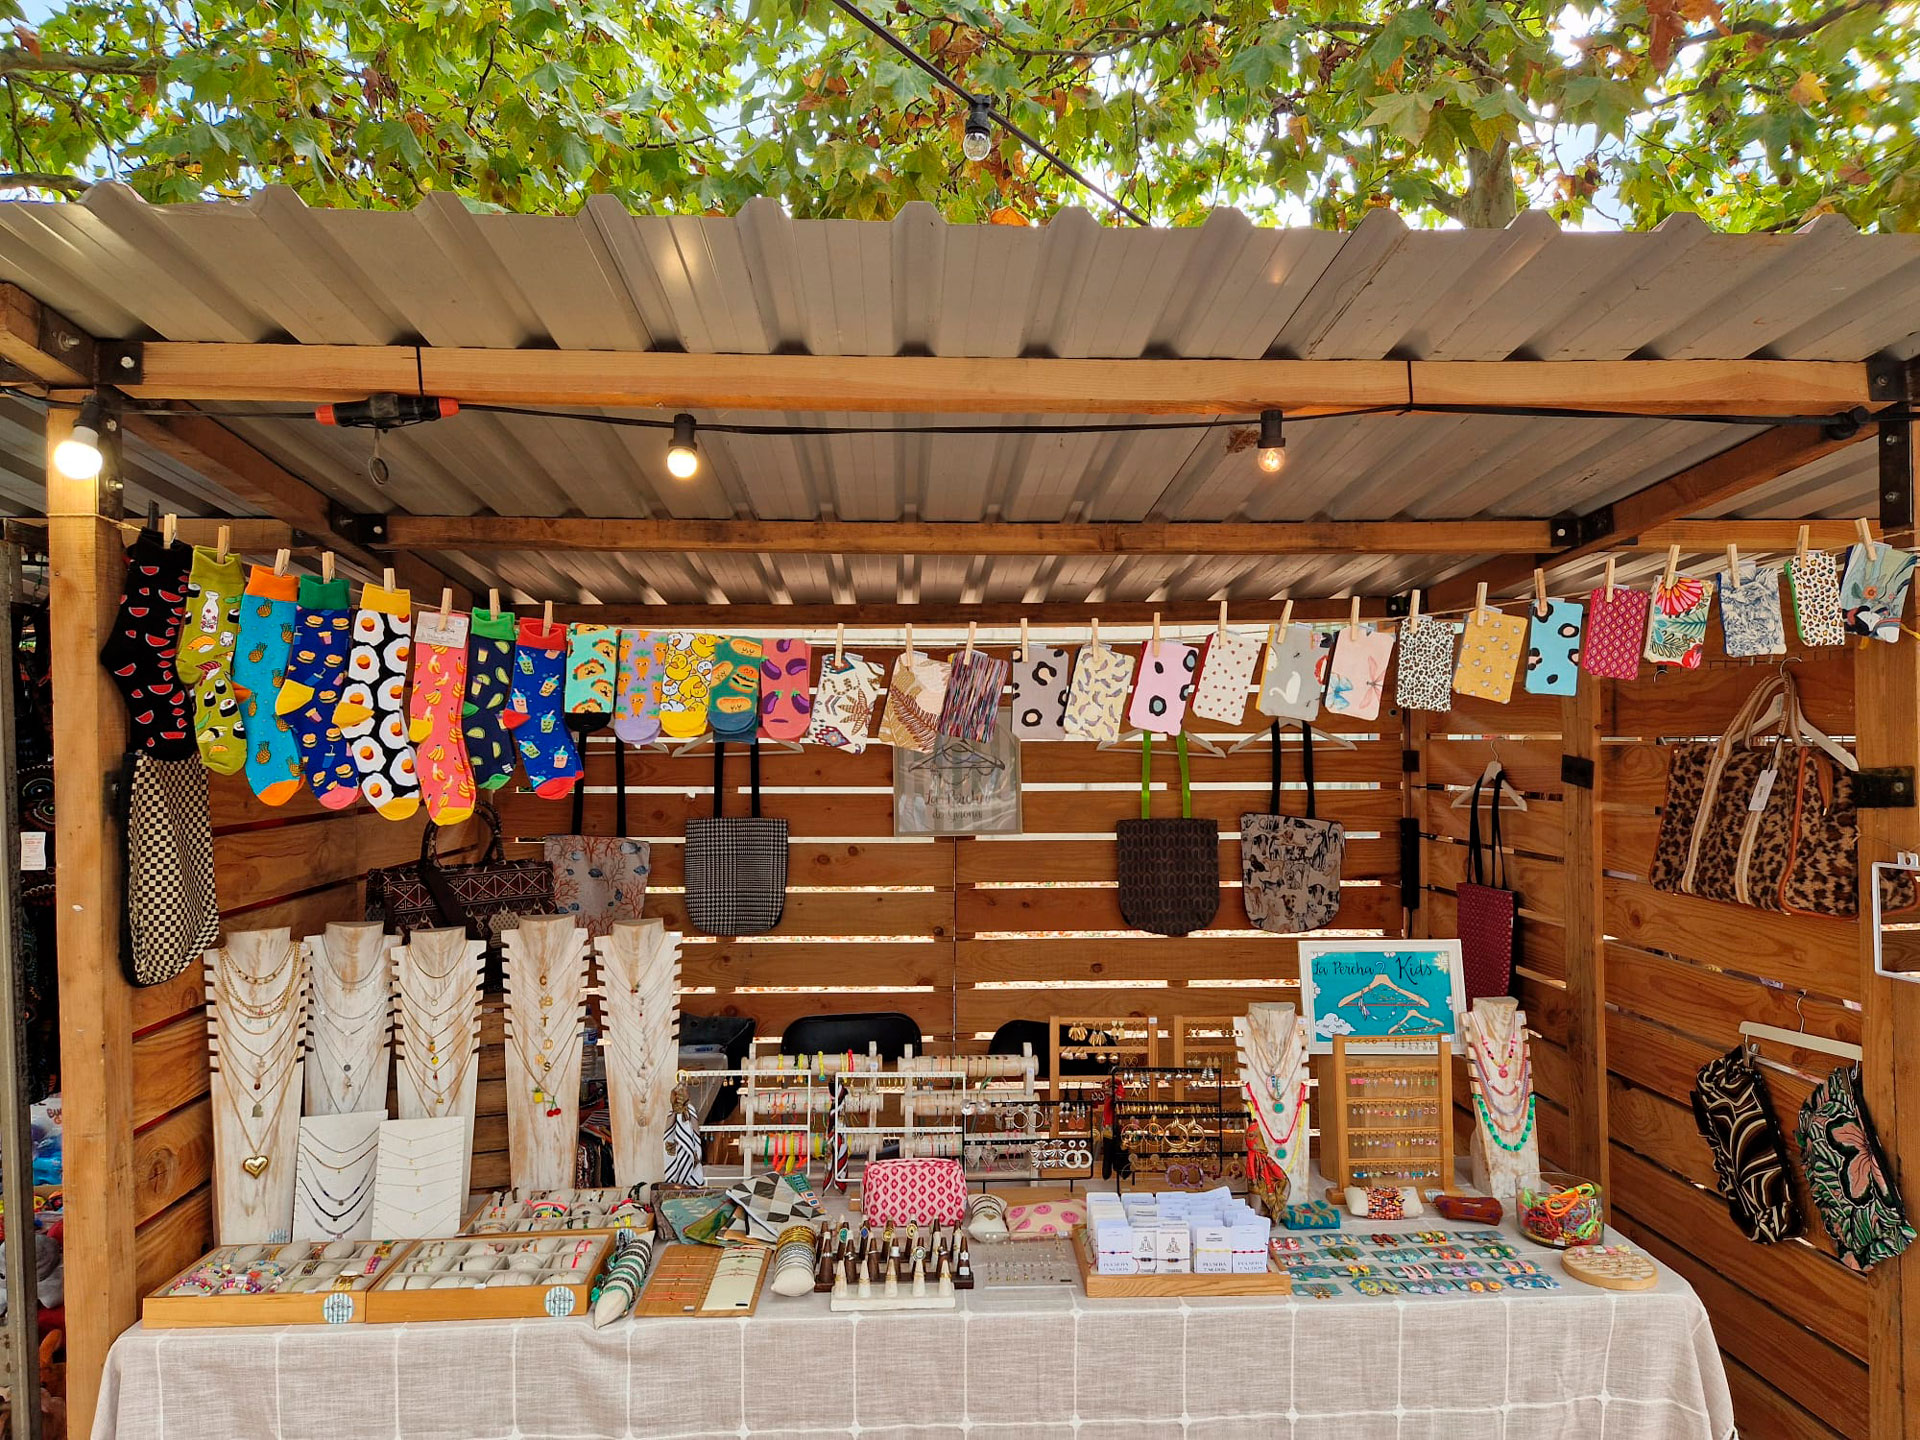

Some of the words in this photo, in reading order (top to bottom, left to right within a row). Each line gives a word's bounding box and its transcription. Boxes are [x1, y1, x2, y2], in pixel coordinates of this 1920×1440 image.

[1313, 961, 1328, 976] La
[1333, 961, 1374, 977] Percha
[1395, 955, 1433, 986] Kids
